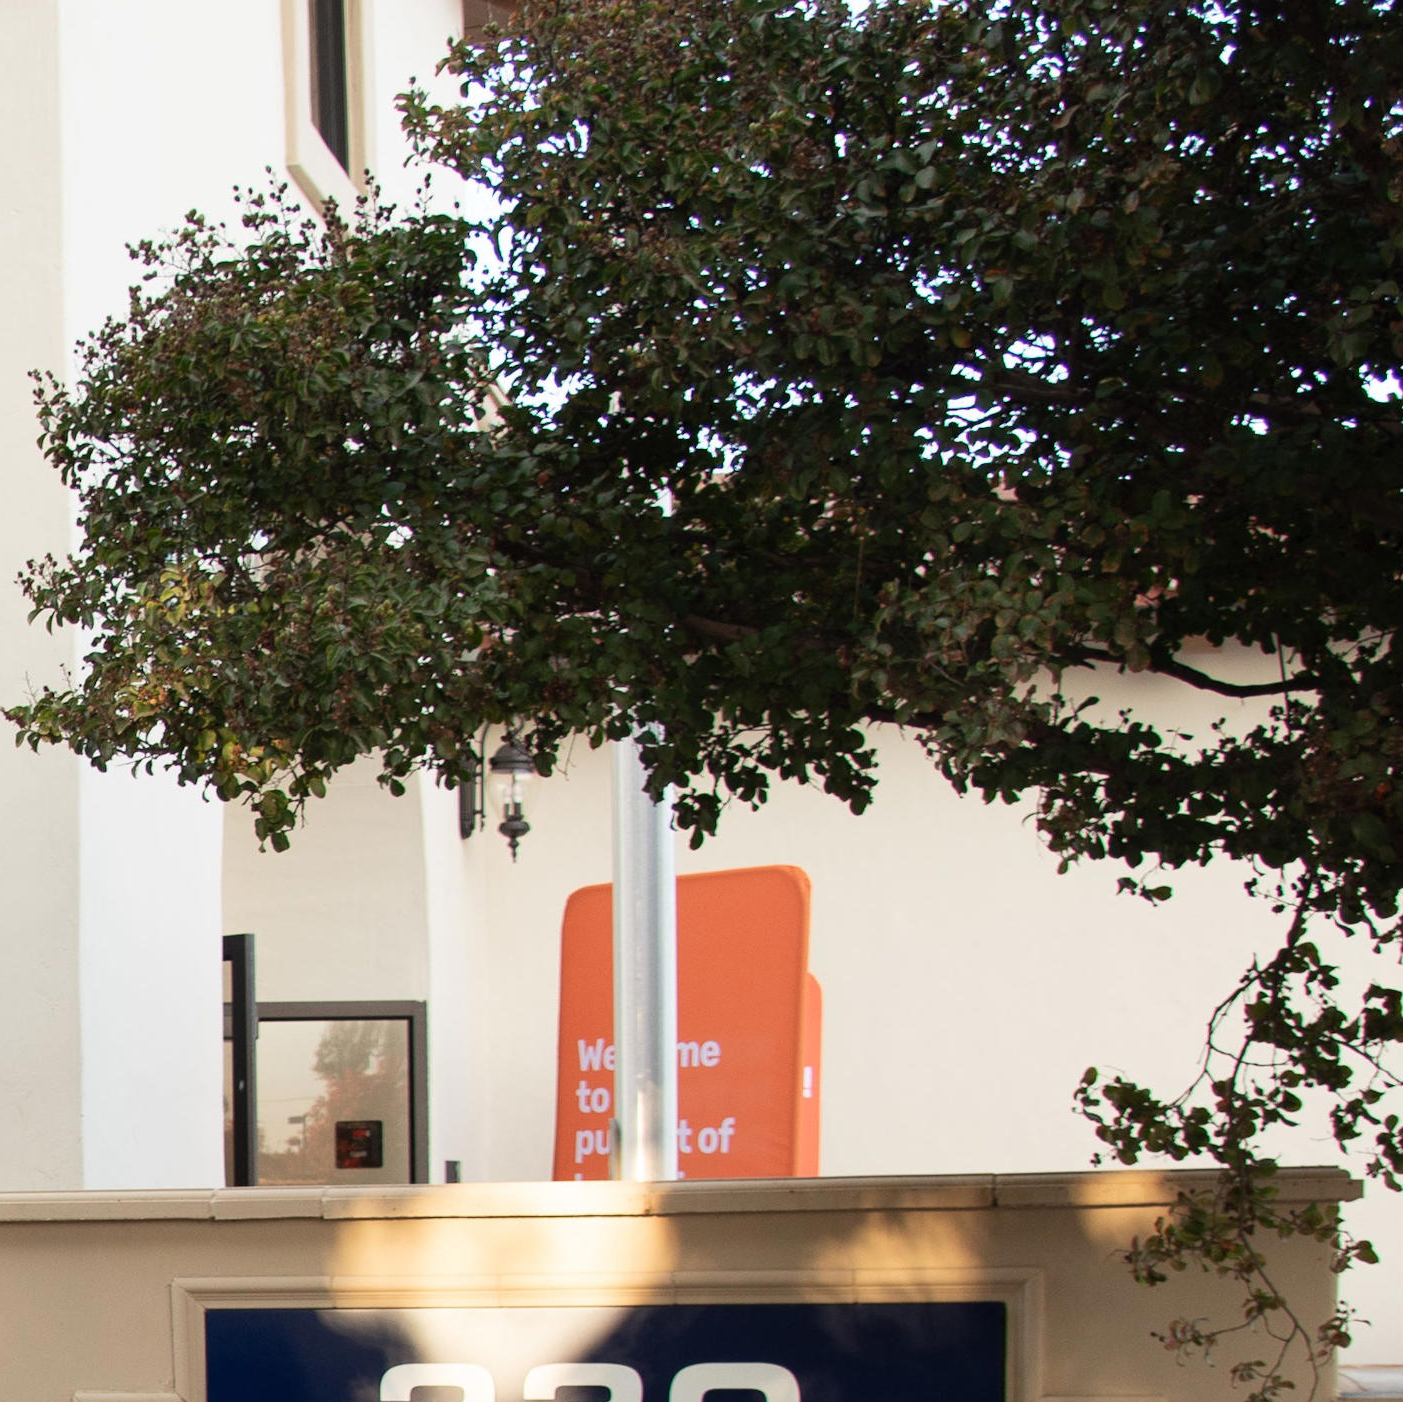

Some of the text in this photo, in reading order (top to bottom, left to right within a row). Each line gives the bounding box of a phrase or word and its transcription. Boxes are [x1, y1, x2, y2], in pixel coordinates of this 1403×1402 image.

[577, 1038, 721, 1072] Weme
[576, 1080, 611, 1114] to
[697, 1117, 736, 1154] of
